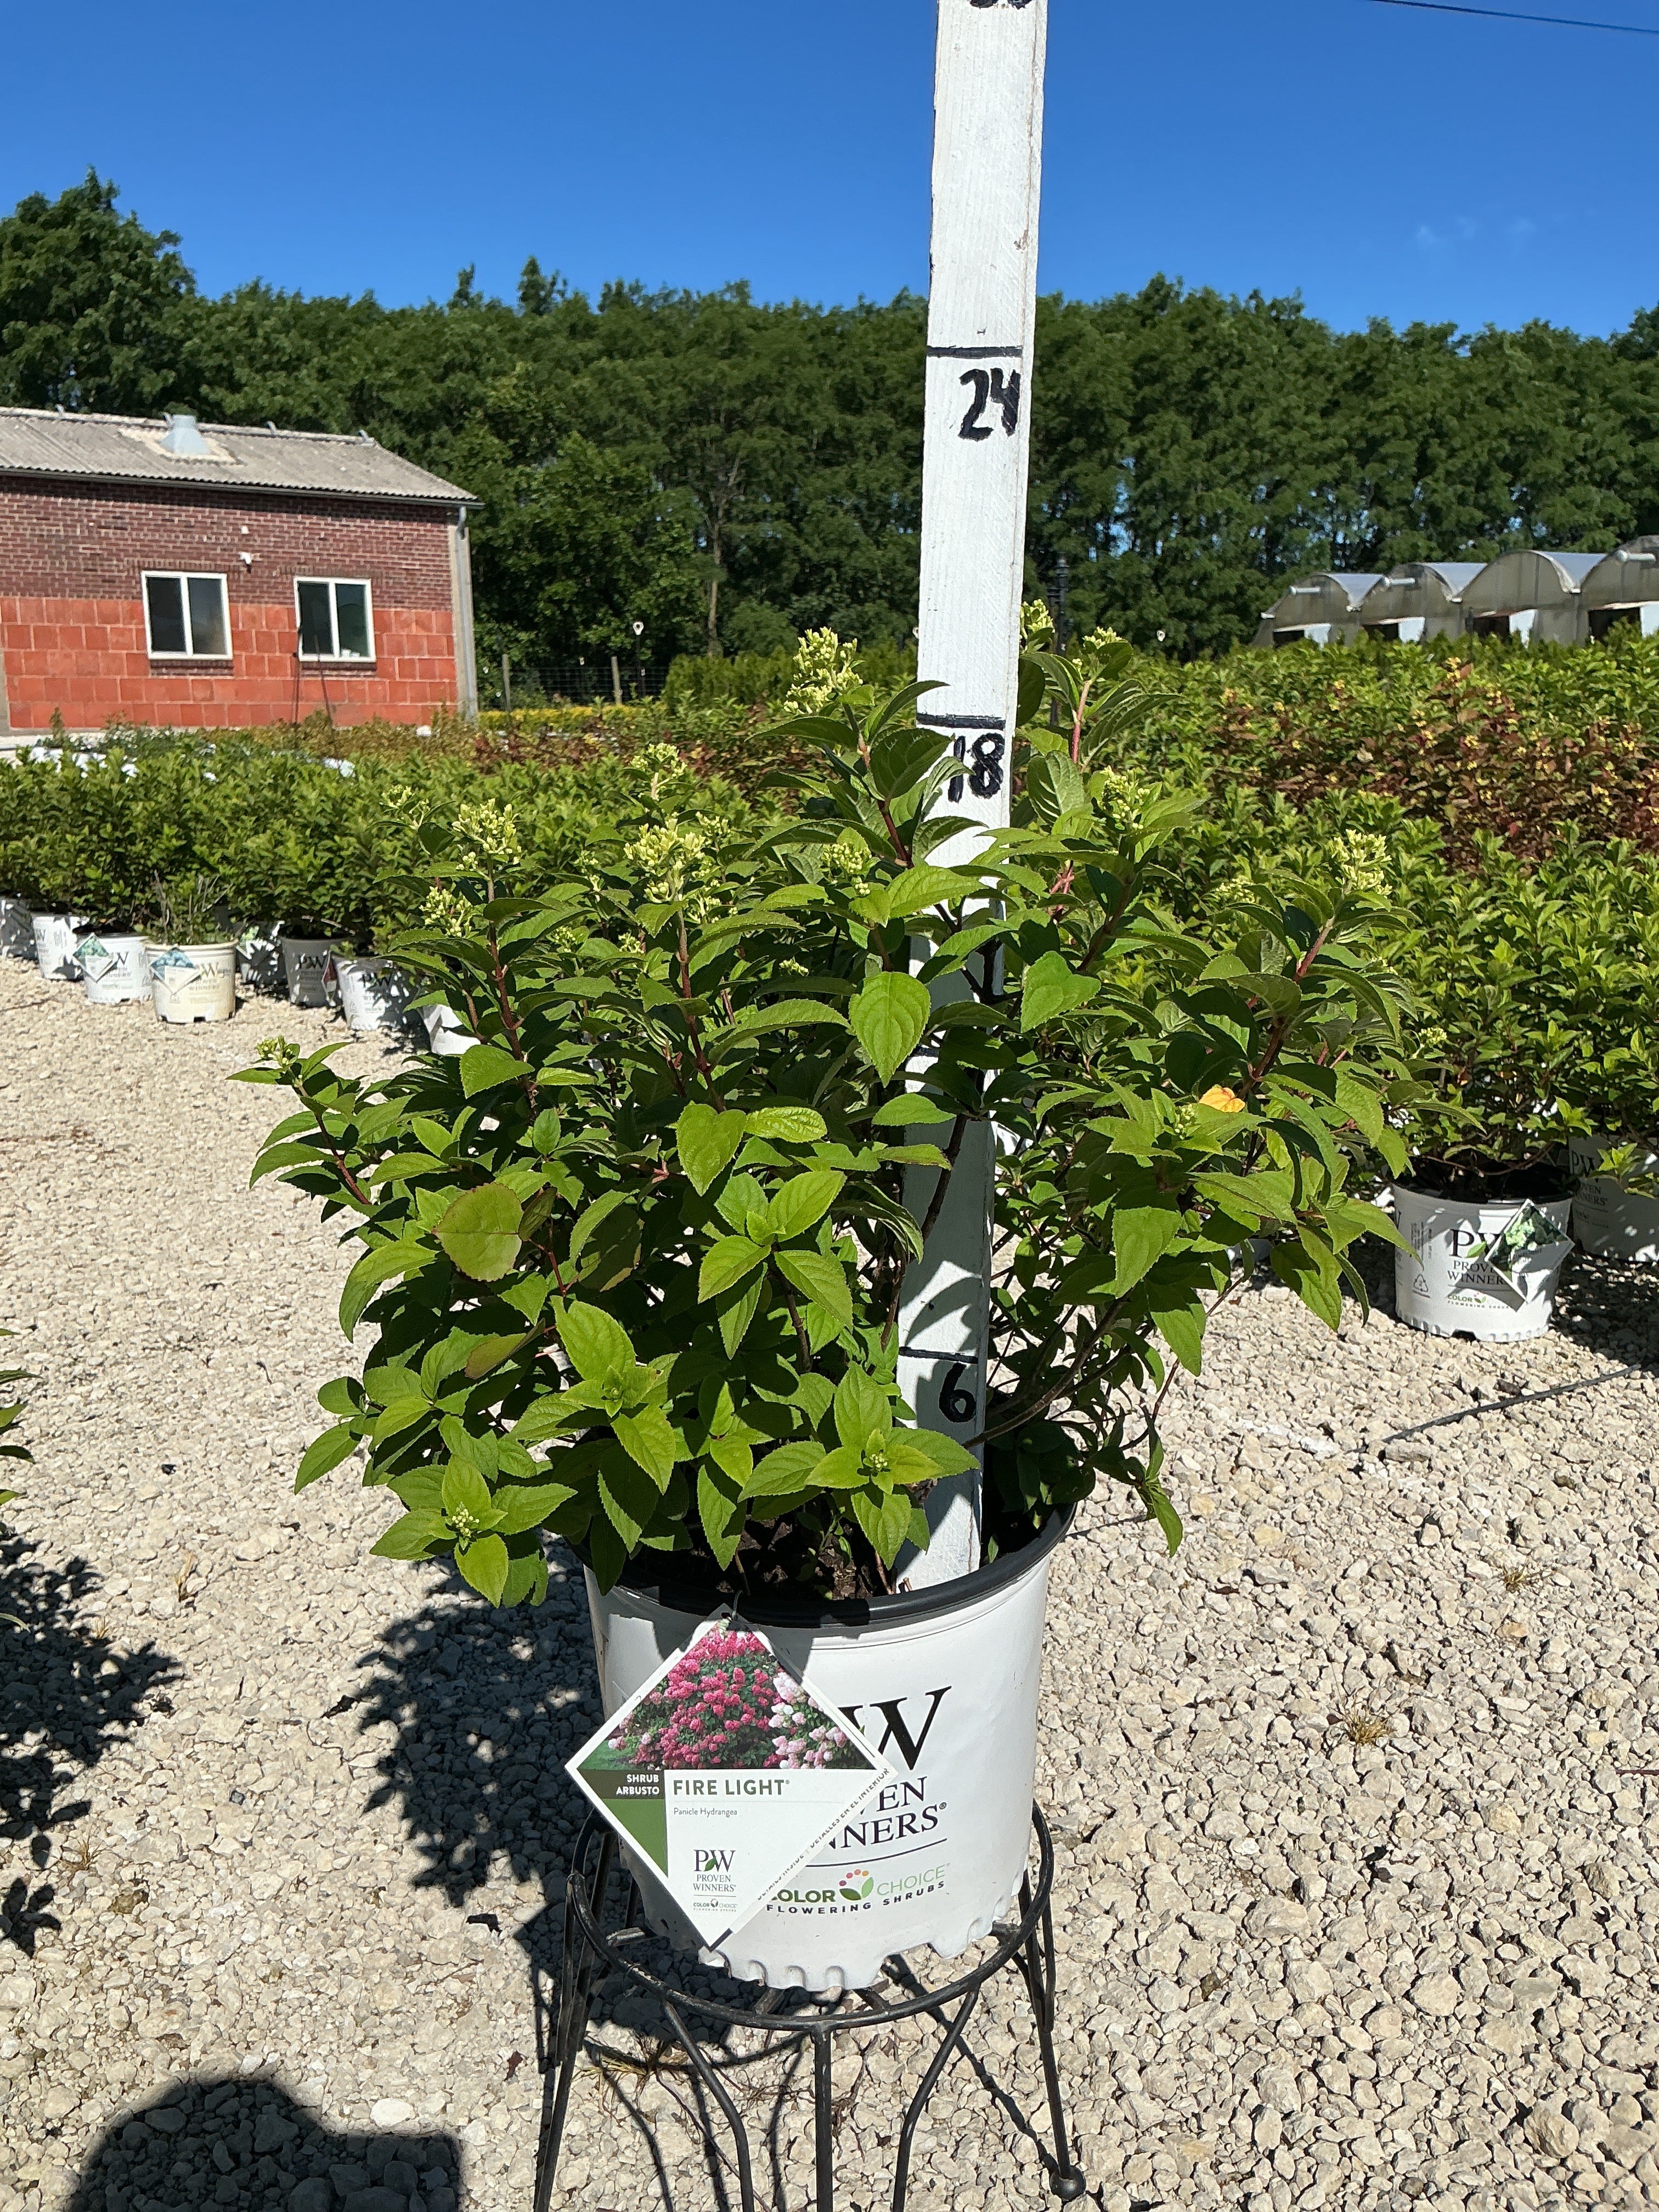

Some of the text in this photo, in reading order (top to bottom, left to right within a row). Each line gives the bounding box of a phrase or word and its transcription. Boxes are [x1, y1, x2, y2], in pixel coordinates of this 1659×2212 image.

[958, 368, 1020, 442] 24
[948, 733, 1005, 803] 18
[1447, 1270, 1508, 1285] WINNER
[939, 1362, 976, 1423] 6
[837, 1686, 952, 1771] W
[627, 1774, 659, 1782] SHRUB
[616, 1786, 660, 1795] ARBUSTO
[673, 1780, 718, 1795] FIRE
[700, 1807, 737, 1818] Hydrangea
[693, 1849, 736, 1872] PW
[696, 1874, 731, 1883] PROVEN
[766, 1880, 944, 1914] FLOWERING SHRUBS
[771, 1889, 836, 1903] OLOR
